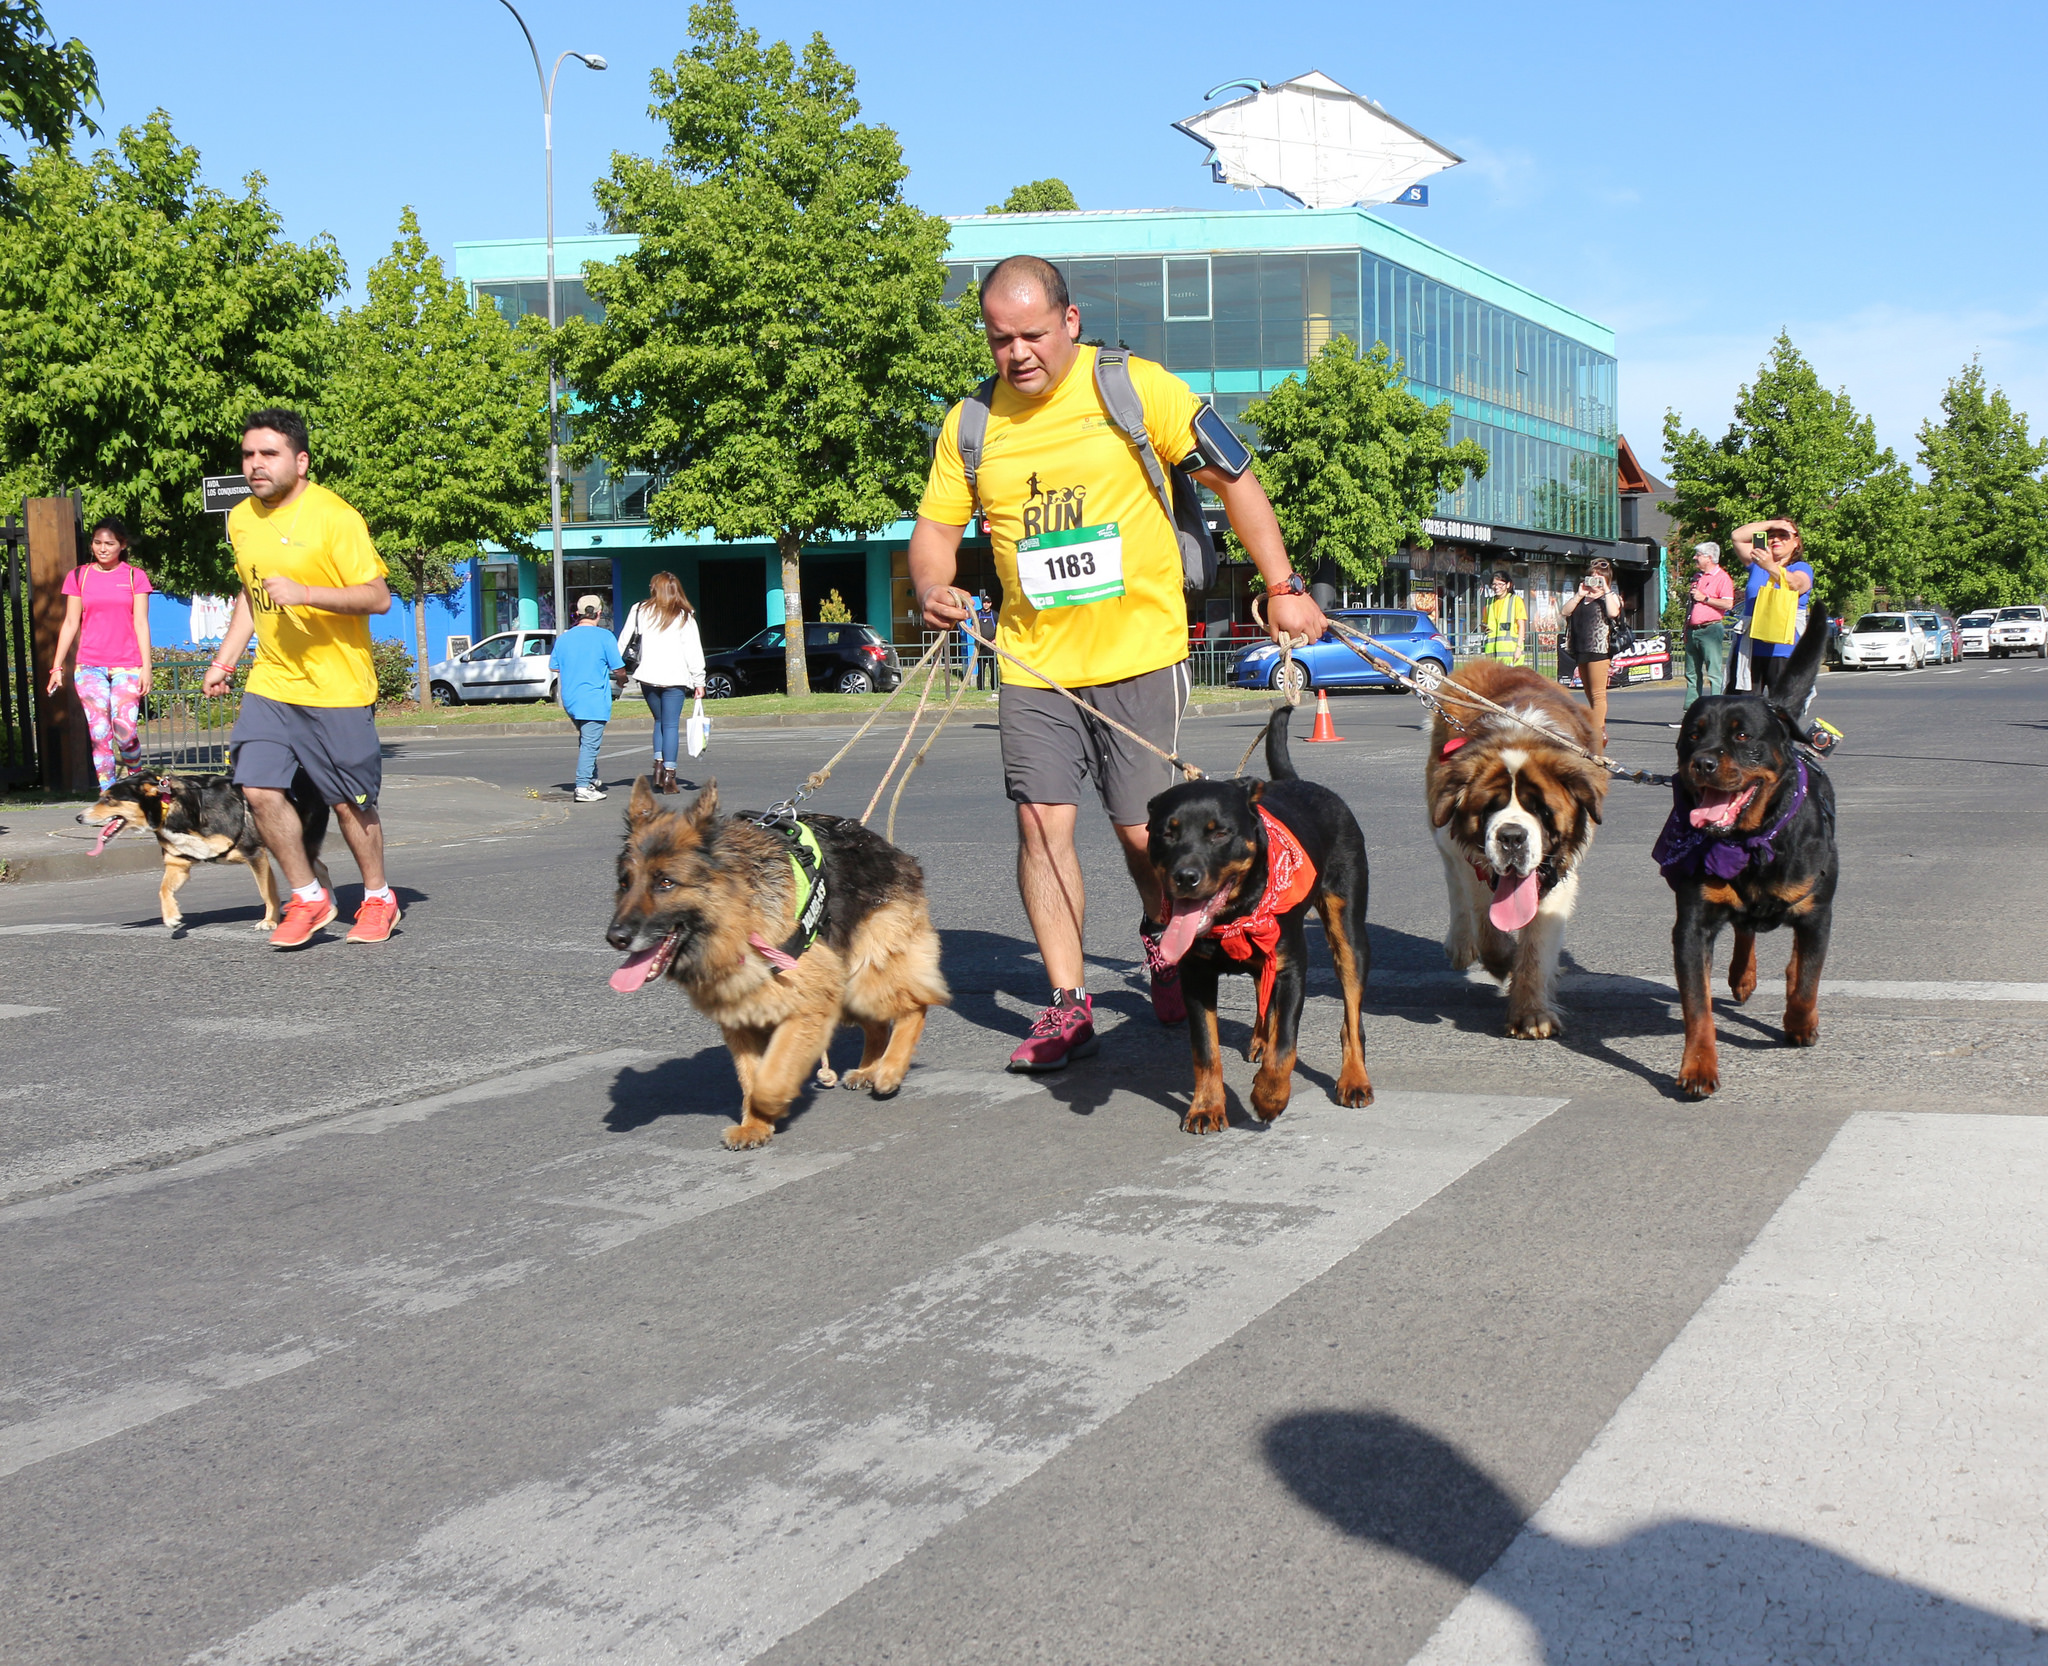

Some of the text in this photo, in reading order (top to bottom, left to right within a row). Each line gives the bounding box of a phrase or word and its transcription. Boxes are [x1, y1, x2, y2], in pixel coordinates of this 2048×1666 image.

[1410, 188, 1422, 201] S
[207, 488, 217, 497] LOS
[1023, 499, 1084, 539] RUN
[1044, 551, 1096, 581] 1183
